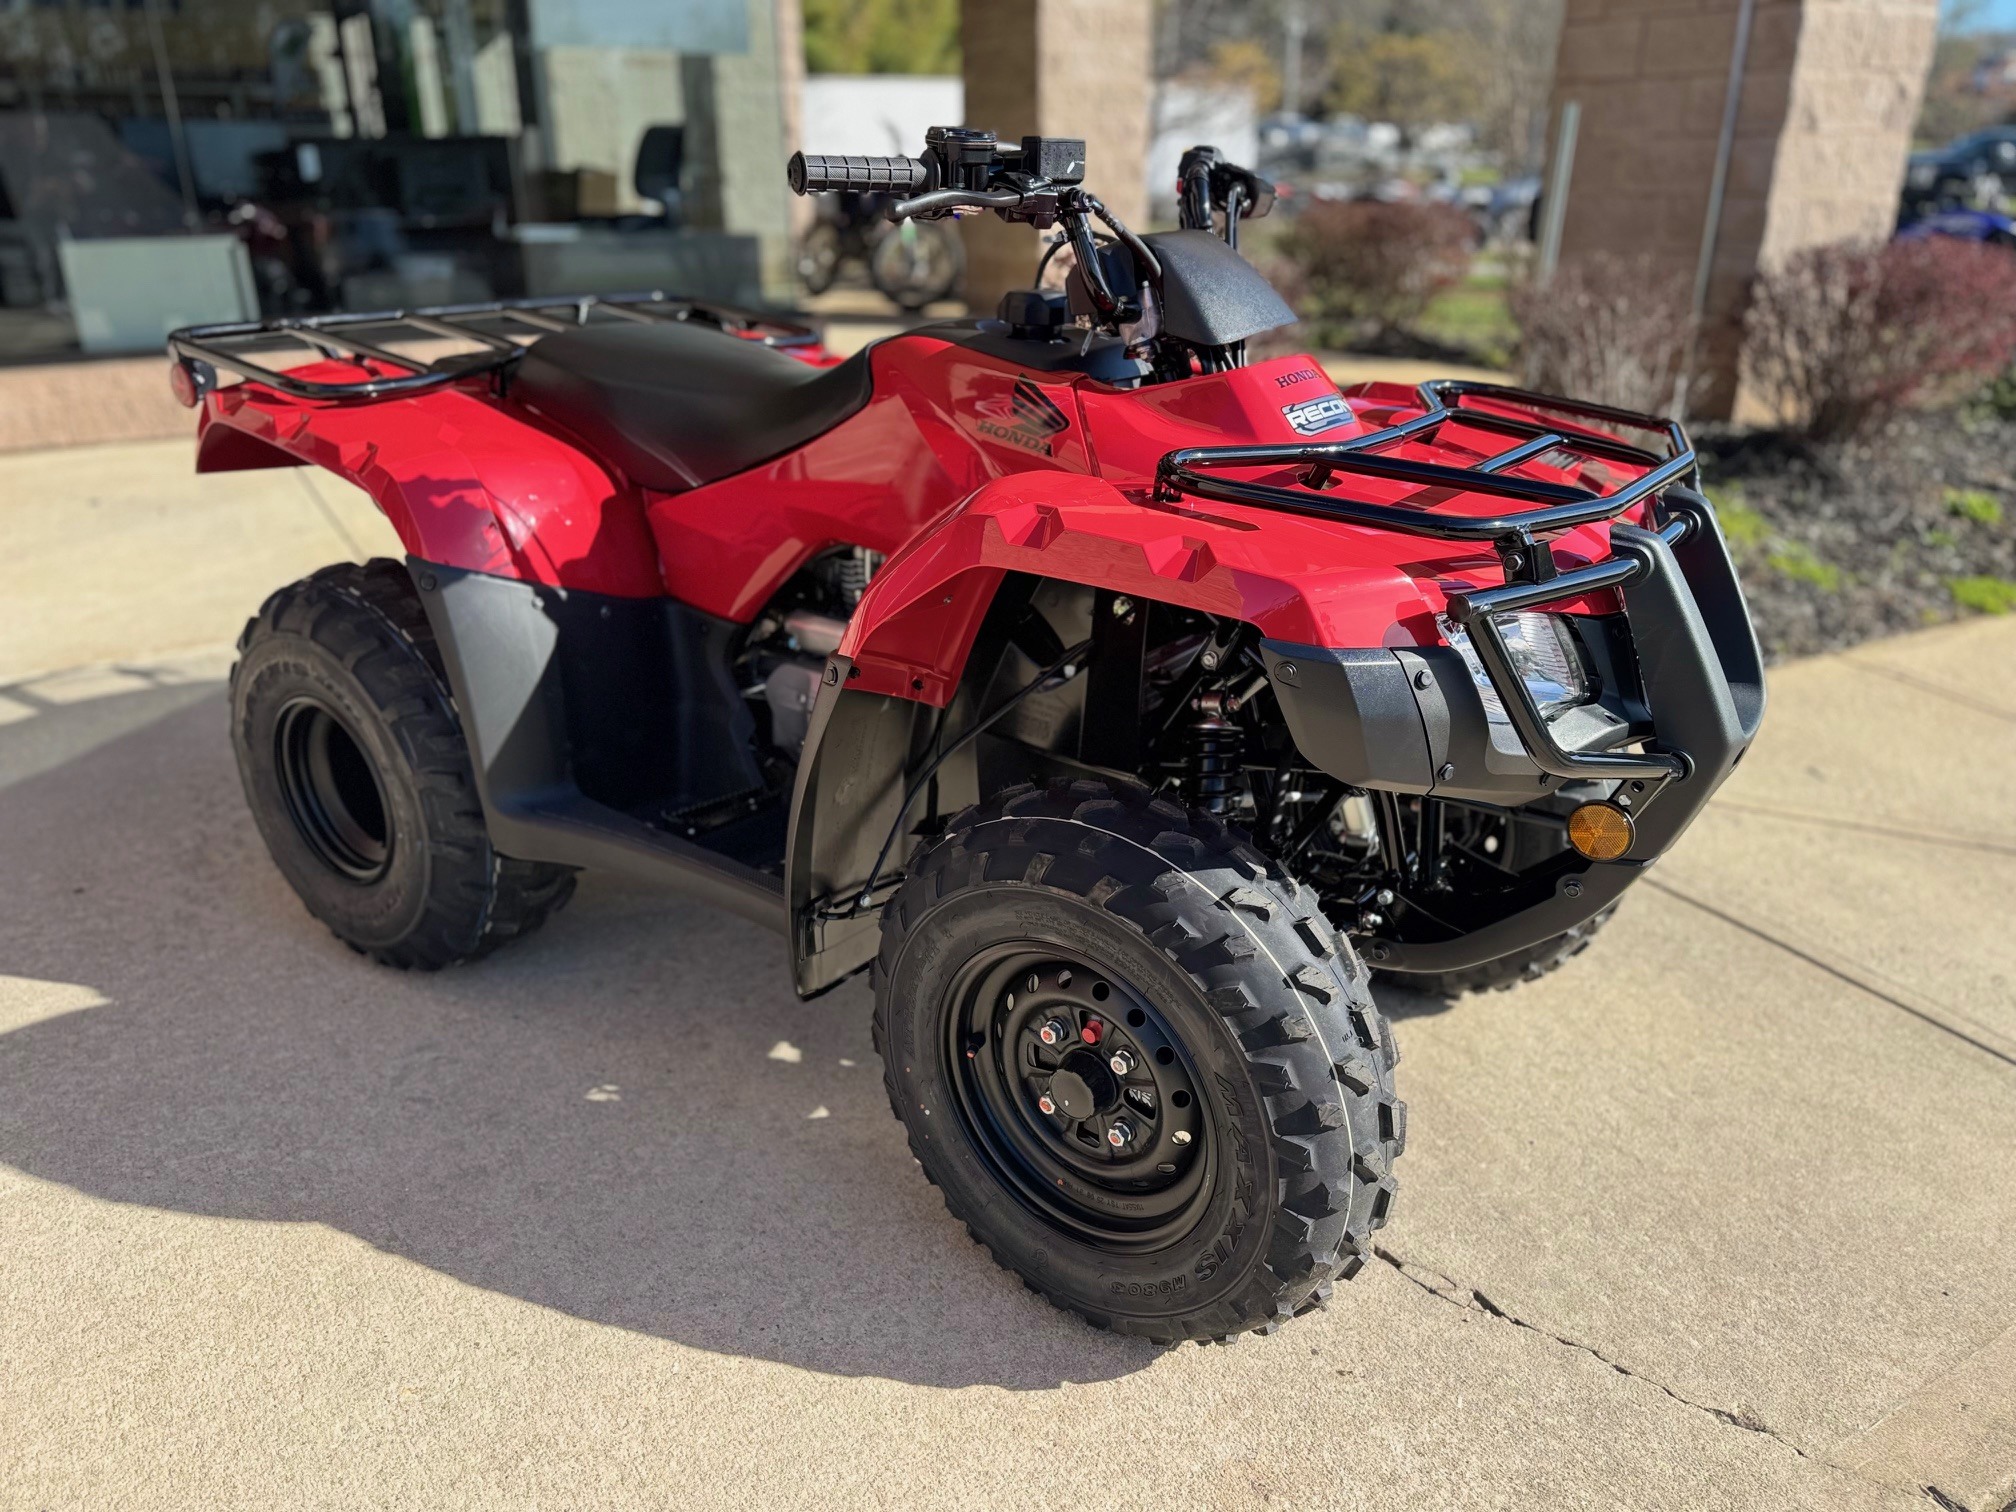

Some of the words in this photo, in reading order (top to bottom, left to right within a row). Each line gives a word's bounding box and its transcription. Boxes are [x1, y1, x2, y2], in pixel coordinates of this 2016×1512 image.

[1275, 369, 1322, 388] HONDA
[1285, 399, 1353, 430] RECON
[977, 420, 1054, 458] HONDA
[1194, 1071, 1252, 1282] MAXXIS
